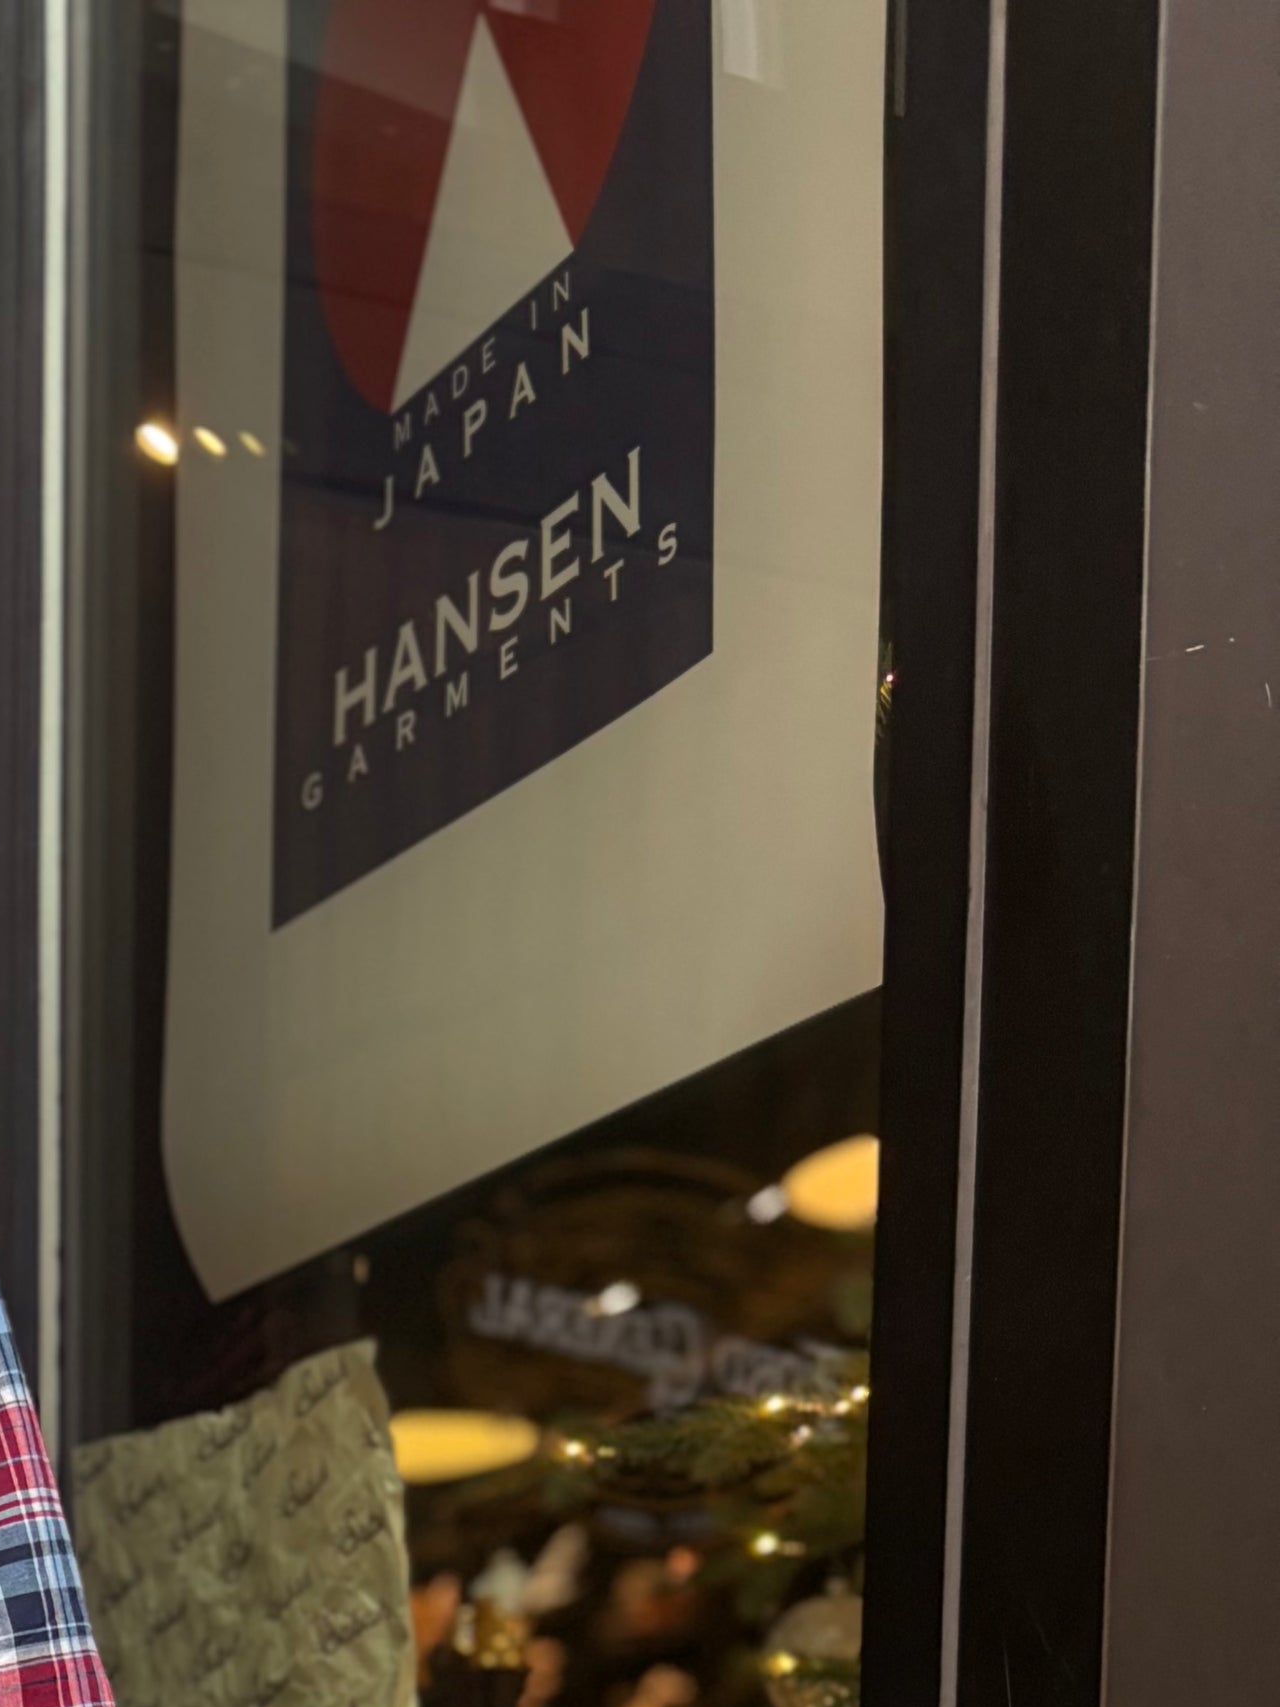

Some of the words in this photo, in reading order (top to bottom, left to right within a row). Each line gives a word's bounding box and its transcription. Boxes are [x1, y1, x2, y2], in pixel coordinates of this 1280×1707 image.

[374, 307, 592, 531] JAPAN
[394, 338, 497, 450] MADE
[529, 271, 572, 331] IN
[301, 523, 679, 811] GARMENTS
[332, 446, 642, 748] HANSEN
